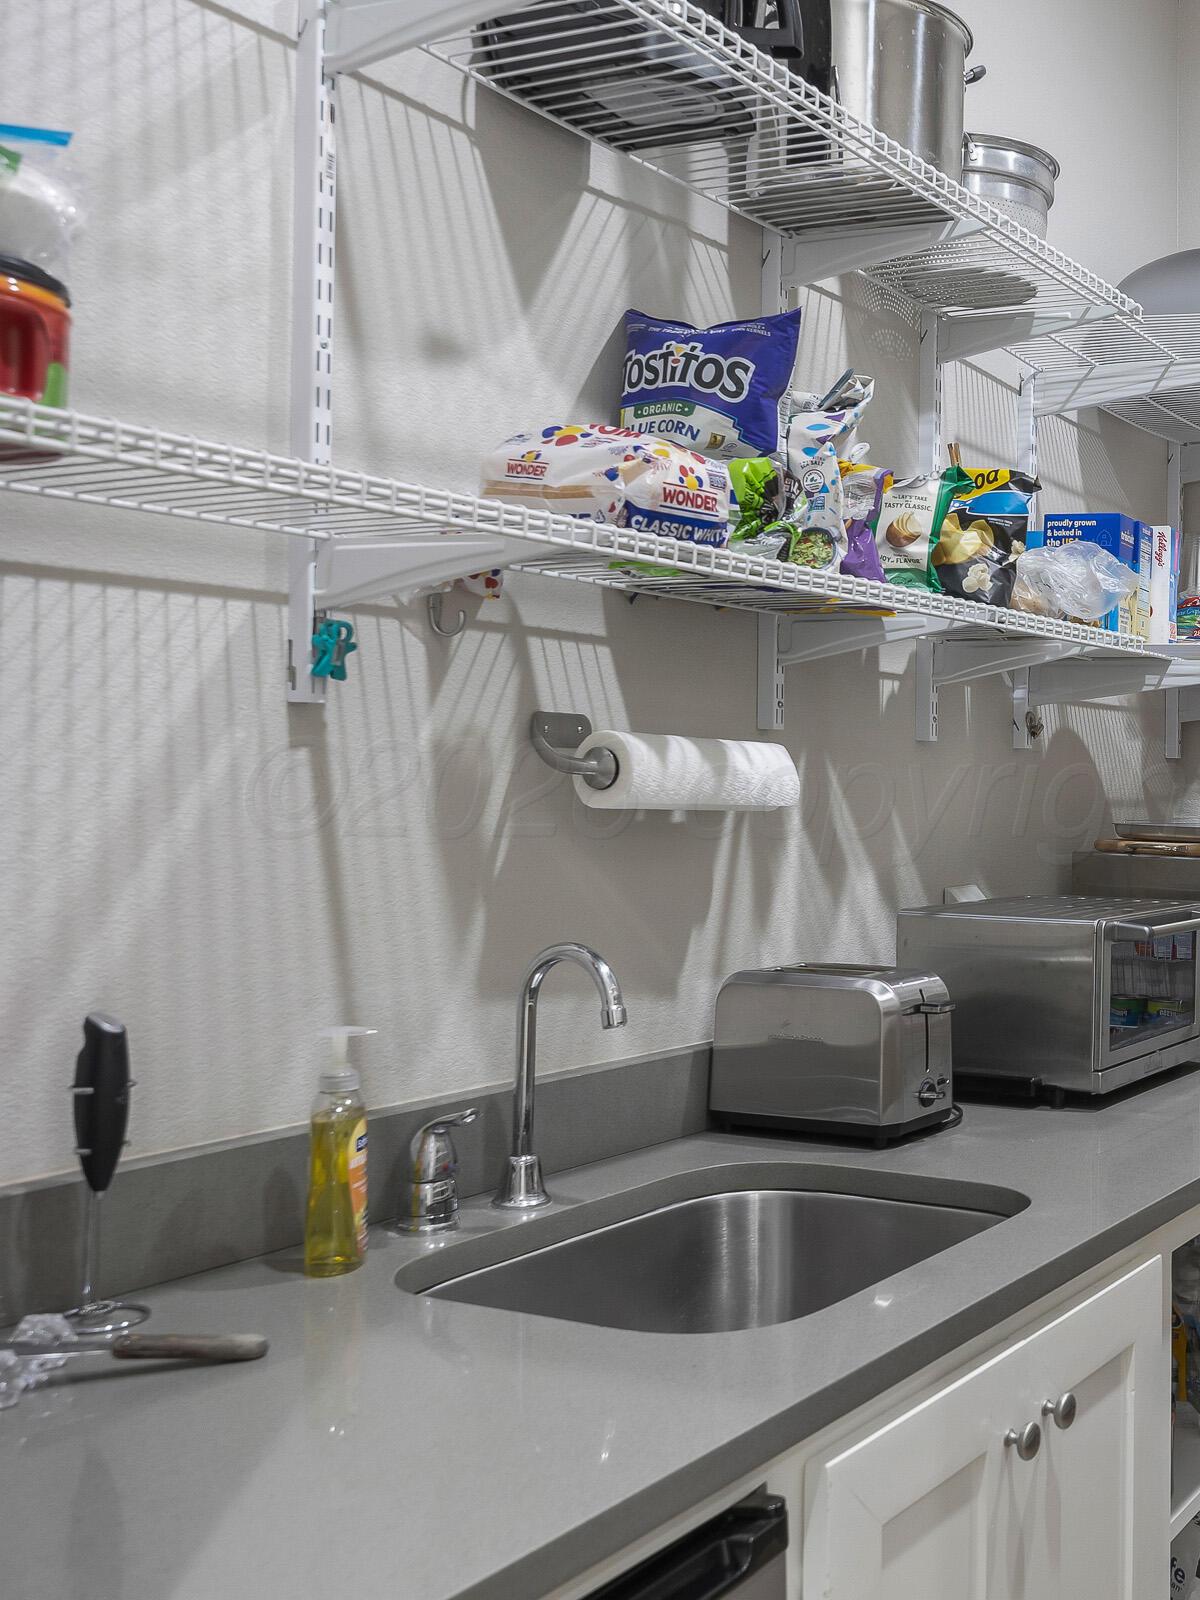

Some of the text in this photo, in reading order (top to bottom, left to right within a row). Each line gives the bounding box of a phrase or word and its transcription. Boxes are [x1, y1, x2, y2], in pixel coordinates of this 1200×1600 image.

[642, 404, 683, 415] ORGANIC
[630, 421, 655, 434] LUE
[657, 419, 700, 441] CORN
[507, 462, 547, 477] WONDER
[662, 486, 718, 513] WONDER
[630, 514, 692, 539] CLASSIC
[1047, 519, 1072, 528] proudly
[1155, 531, 1168, 568] Kellogg's
